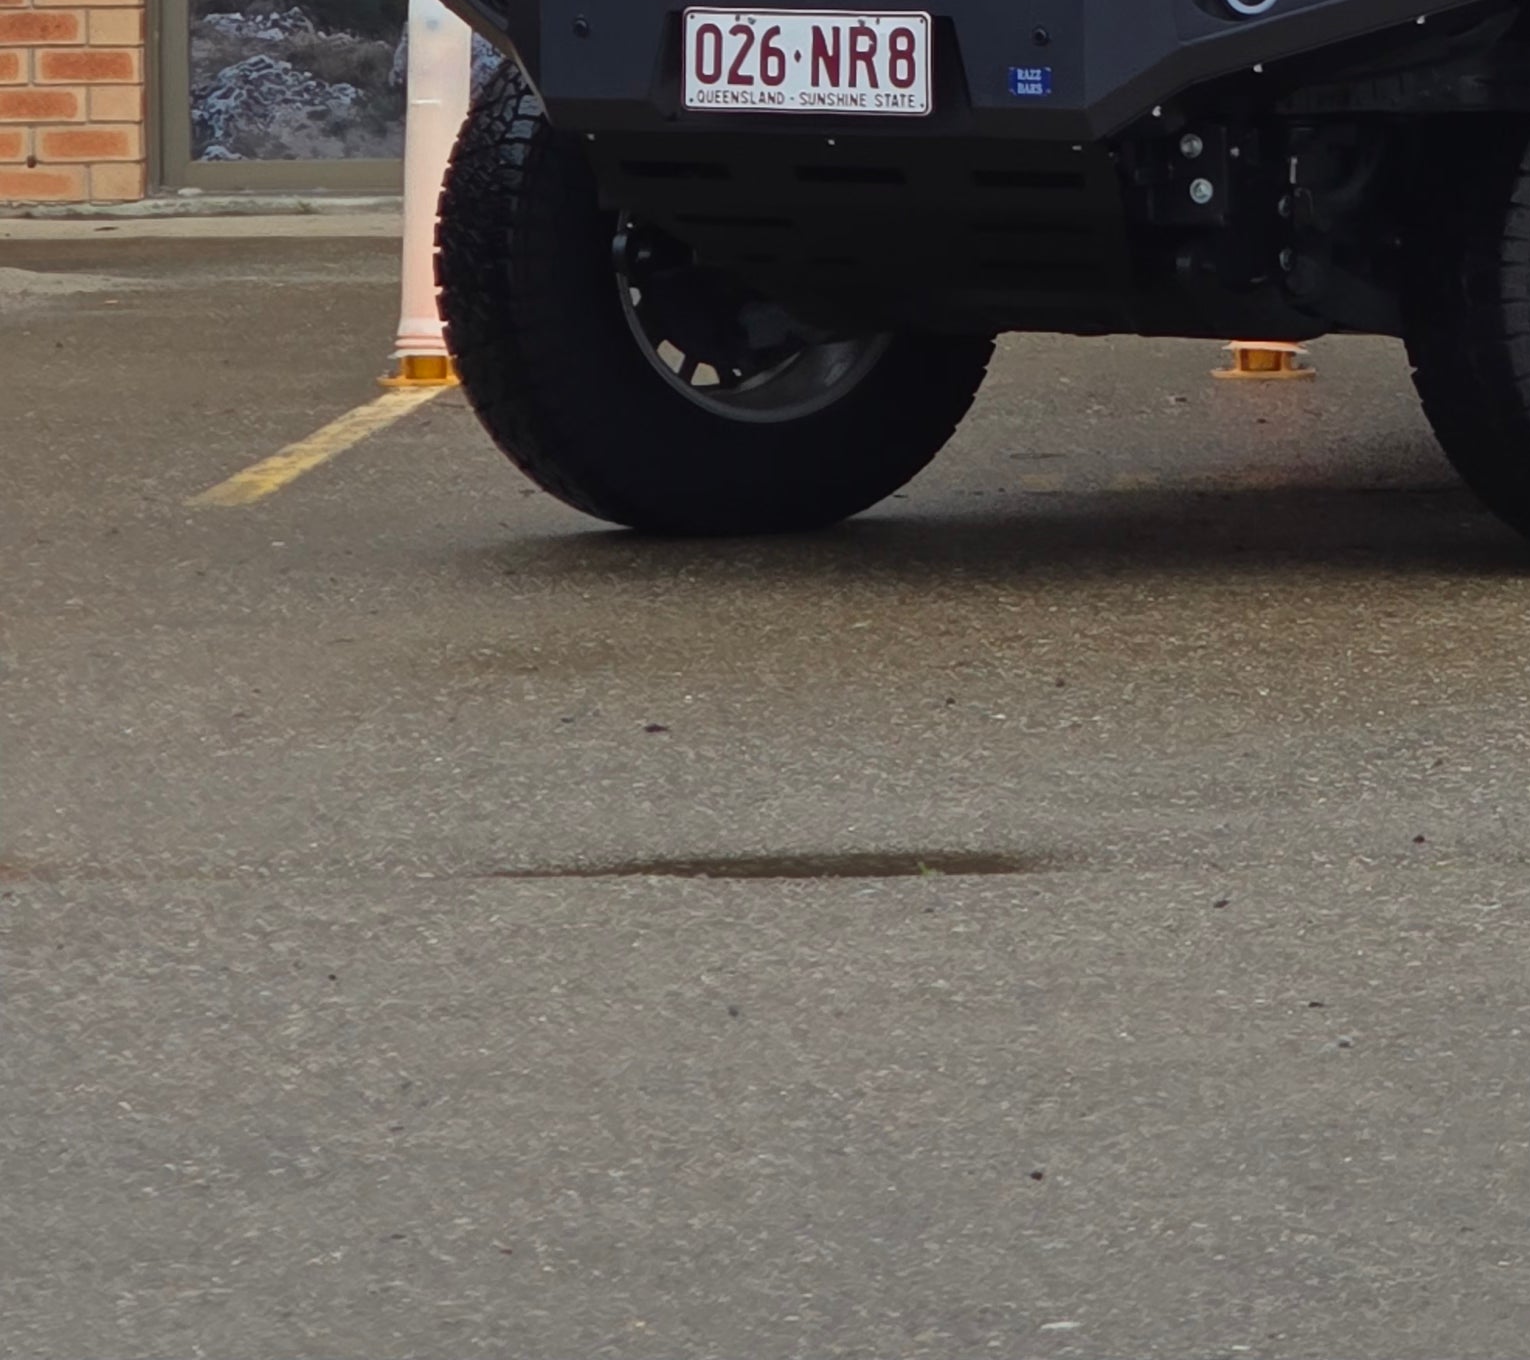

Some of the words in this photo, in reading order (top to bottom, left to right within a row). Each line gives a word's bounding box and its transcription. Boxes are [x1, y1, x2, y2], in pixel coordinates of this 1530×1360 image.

[696, 89, 785, 105] QUEENSLAND
[799, 92, 867, 108] SUNSHINE
[874, 93, 916, 108] STATE
